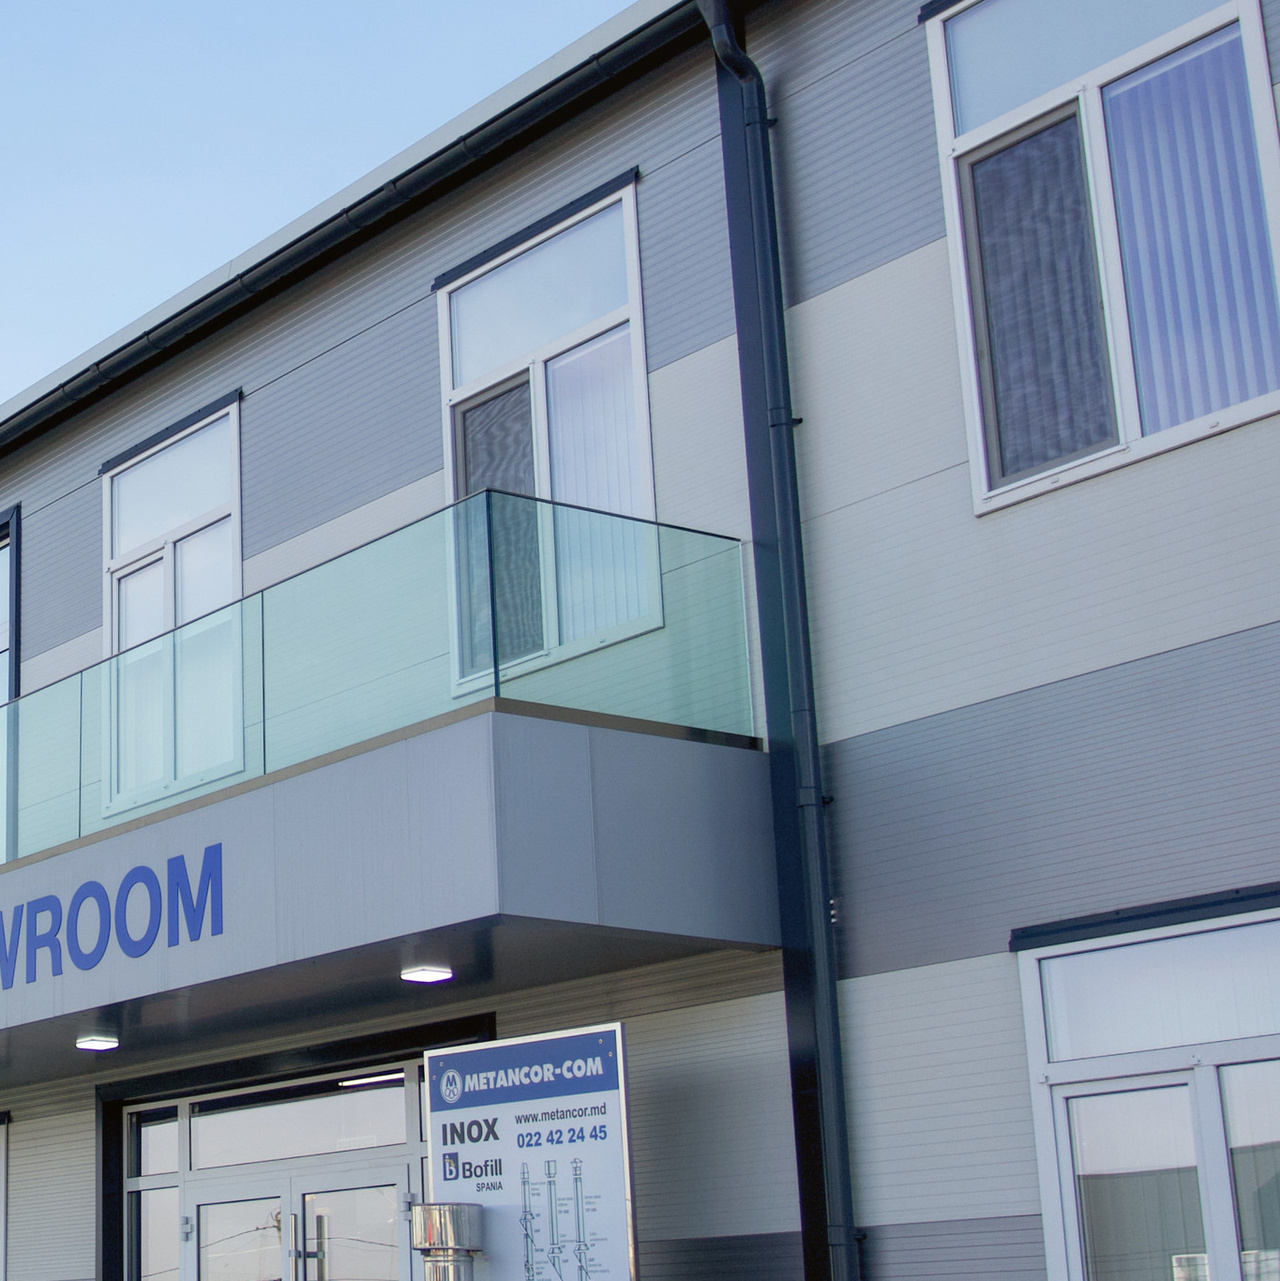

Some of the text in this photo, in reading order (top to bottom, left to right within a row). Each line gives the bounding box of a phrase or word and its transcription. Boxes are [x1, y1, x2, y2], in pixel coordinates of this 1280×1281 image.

[464, 1056, 604, 1092] METANCOR-COM
[514, 1102, 607, 1125] www.metancor.md
[441, 1117, 500, 1146] INOX
[516, 1124, 608, 1149] 022 42 24 45
[461, 1158, 503, 1180] Bofill
[475, 1180, 504, 1193] SPANIA
